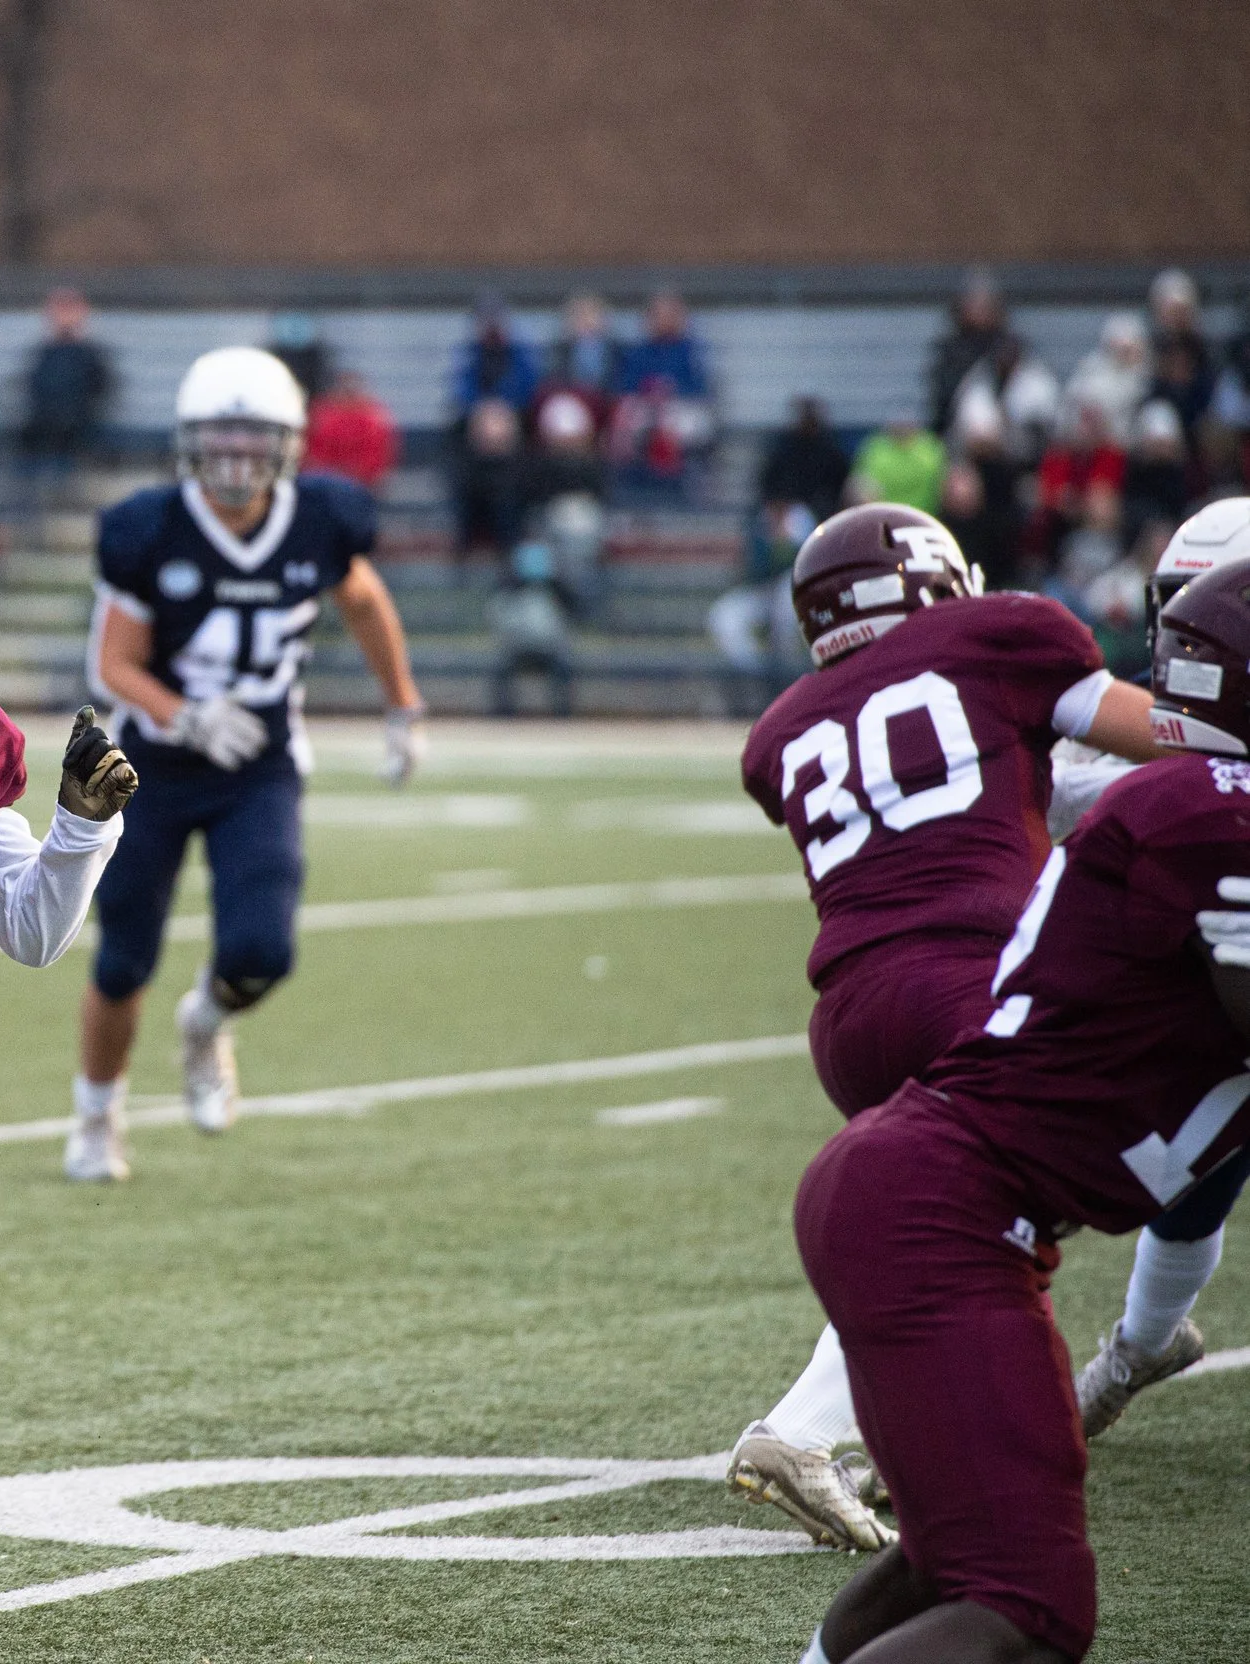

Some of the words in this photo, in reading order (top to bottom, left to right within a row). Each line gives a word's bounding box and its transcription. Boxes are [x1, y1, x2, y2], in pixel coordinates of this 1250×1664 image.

[171, 605, 318, 708] 45
[816, 624, 876, 659] Riddell
[781, 670, 984, 882] 30
